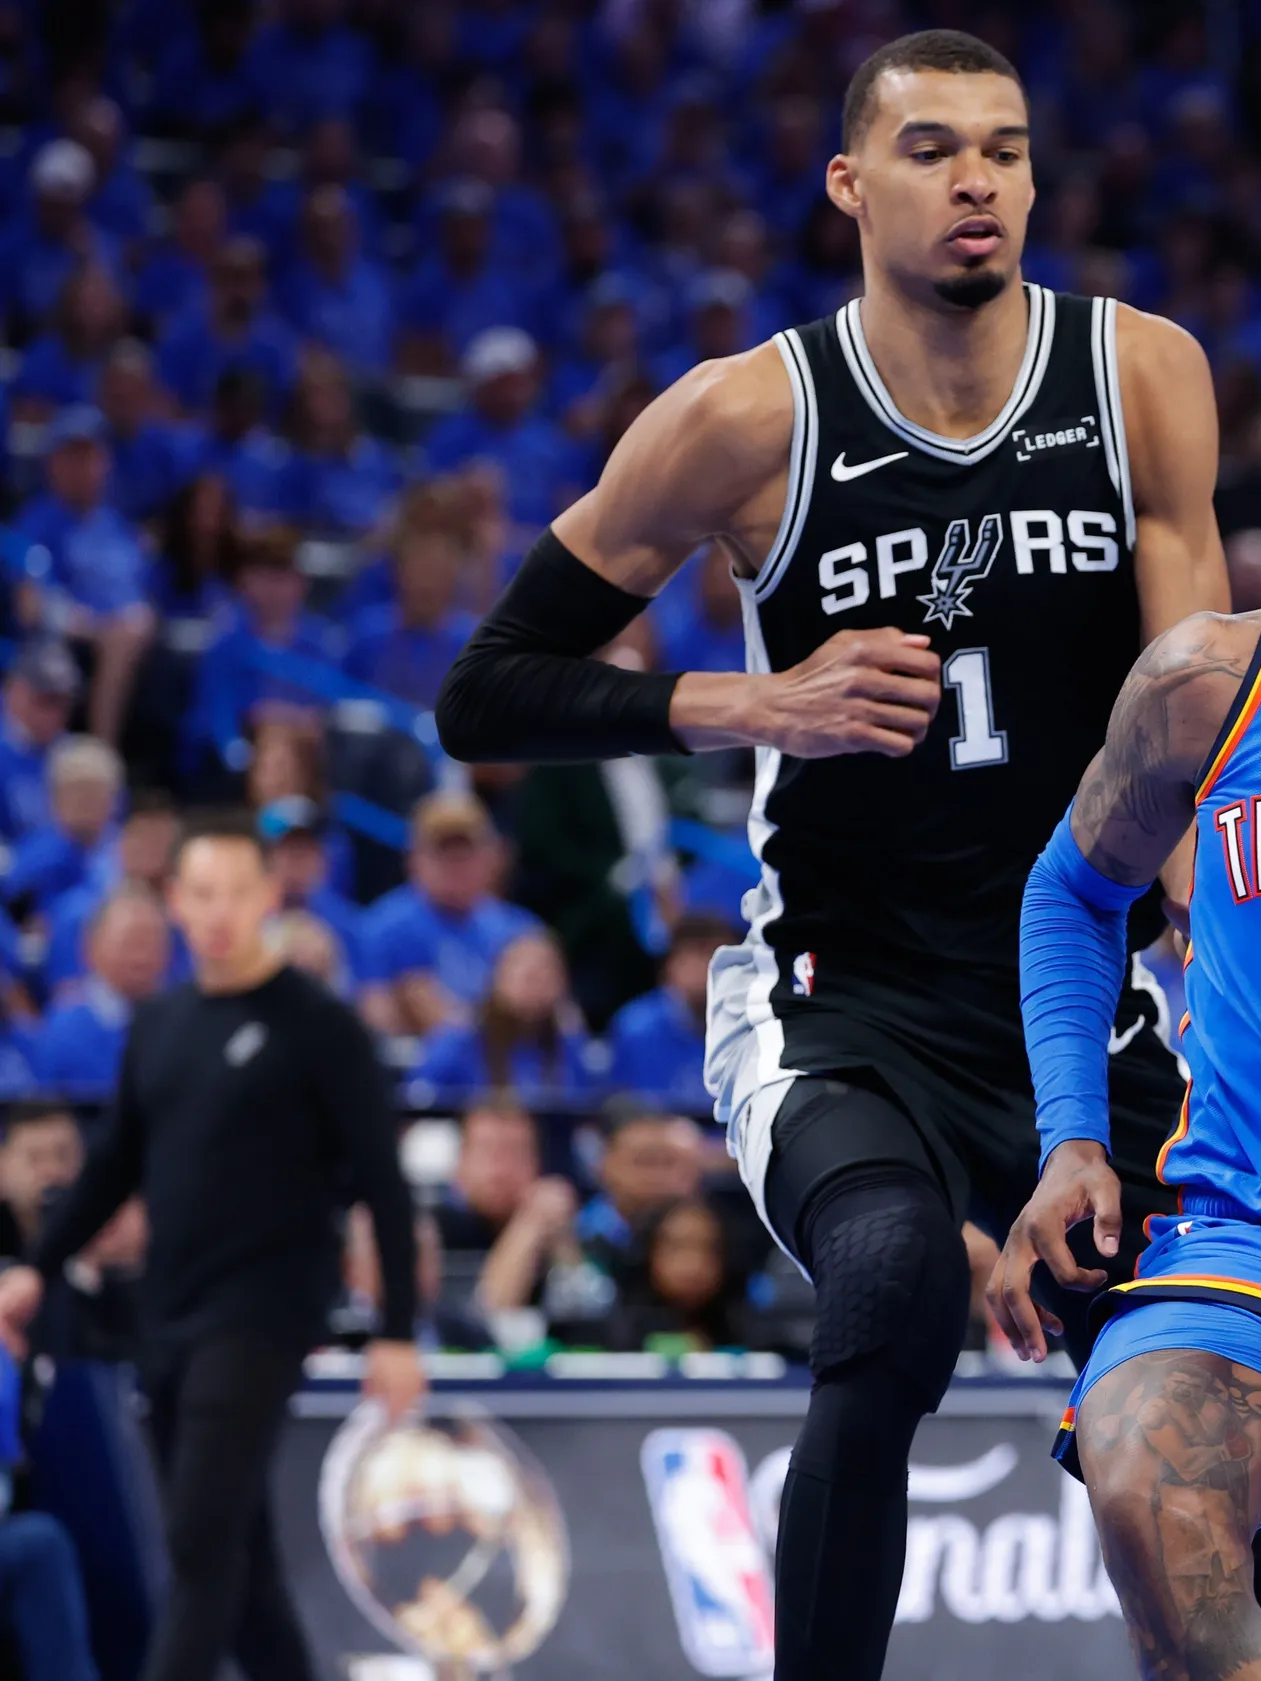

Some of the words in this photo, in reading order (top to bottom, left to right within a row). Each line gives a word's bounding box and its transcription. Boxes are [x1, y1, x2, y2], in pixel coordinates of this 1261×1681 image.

[1024, 426, 1087, 451] LEDGER
[818, 509, 1119, 630] SPURS
[943, 646, 1009, 770] 1
